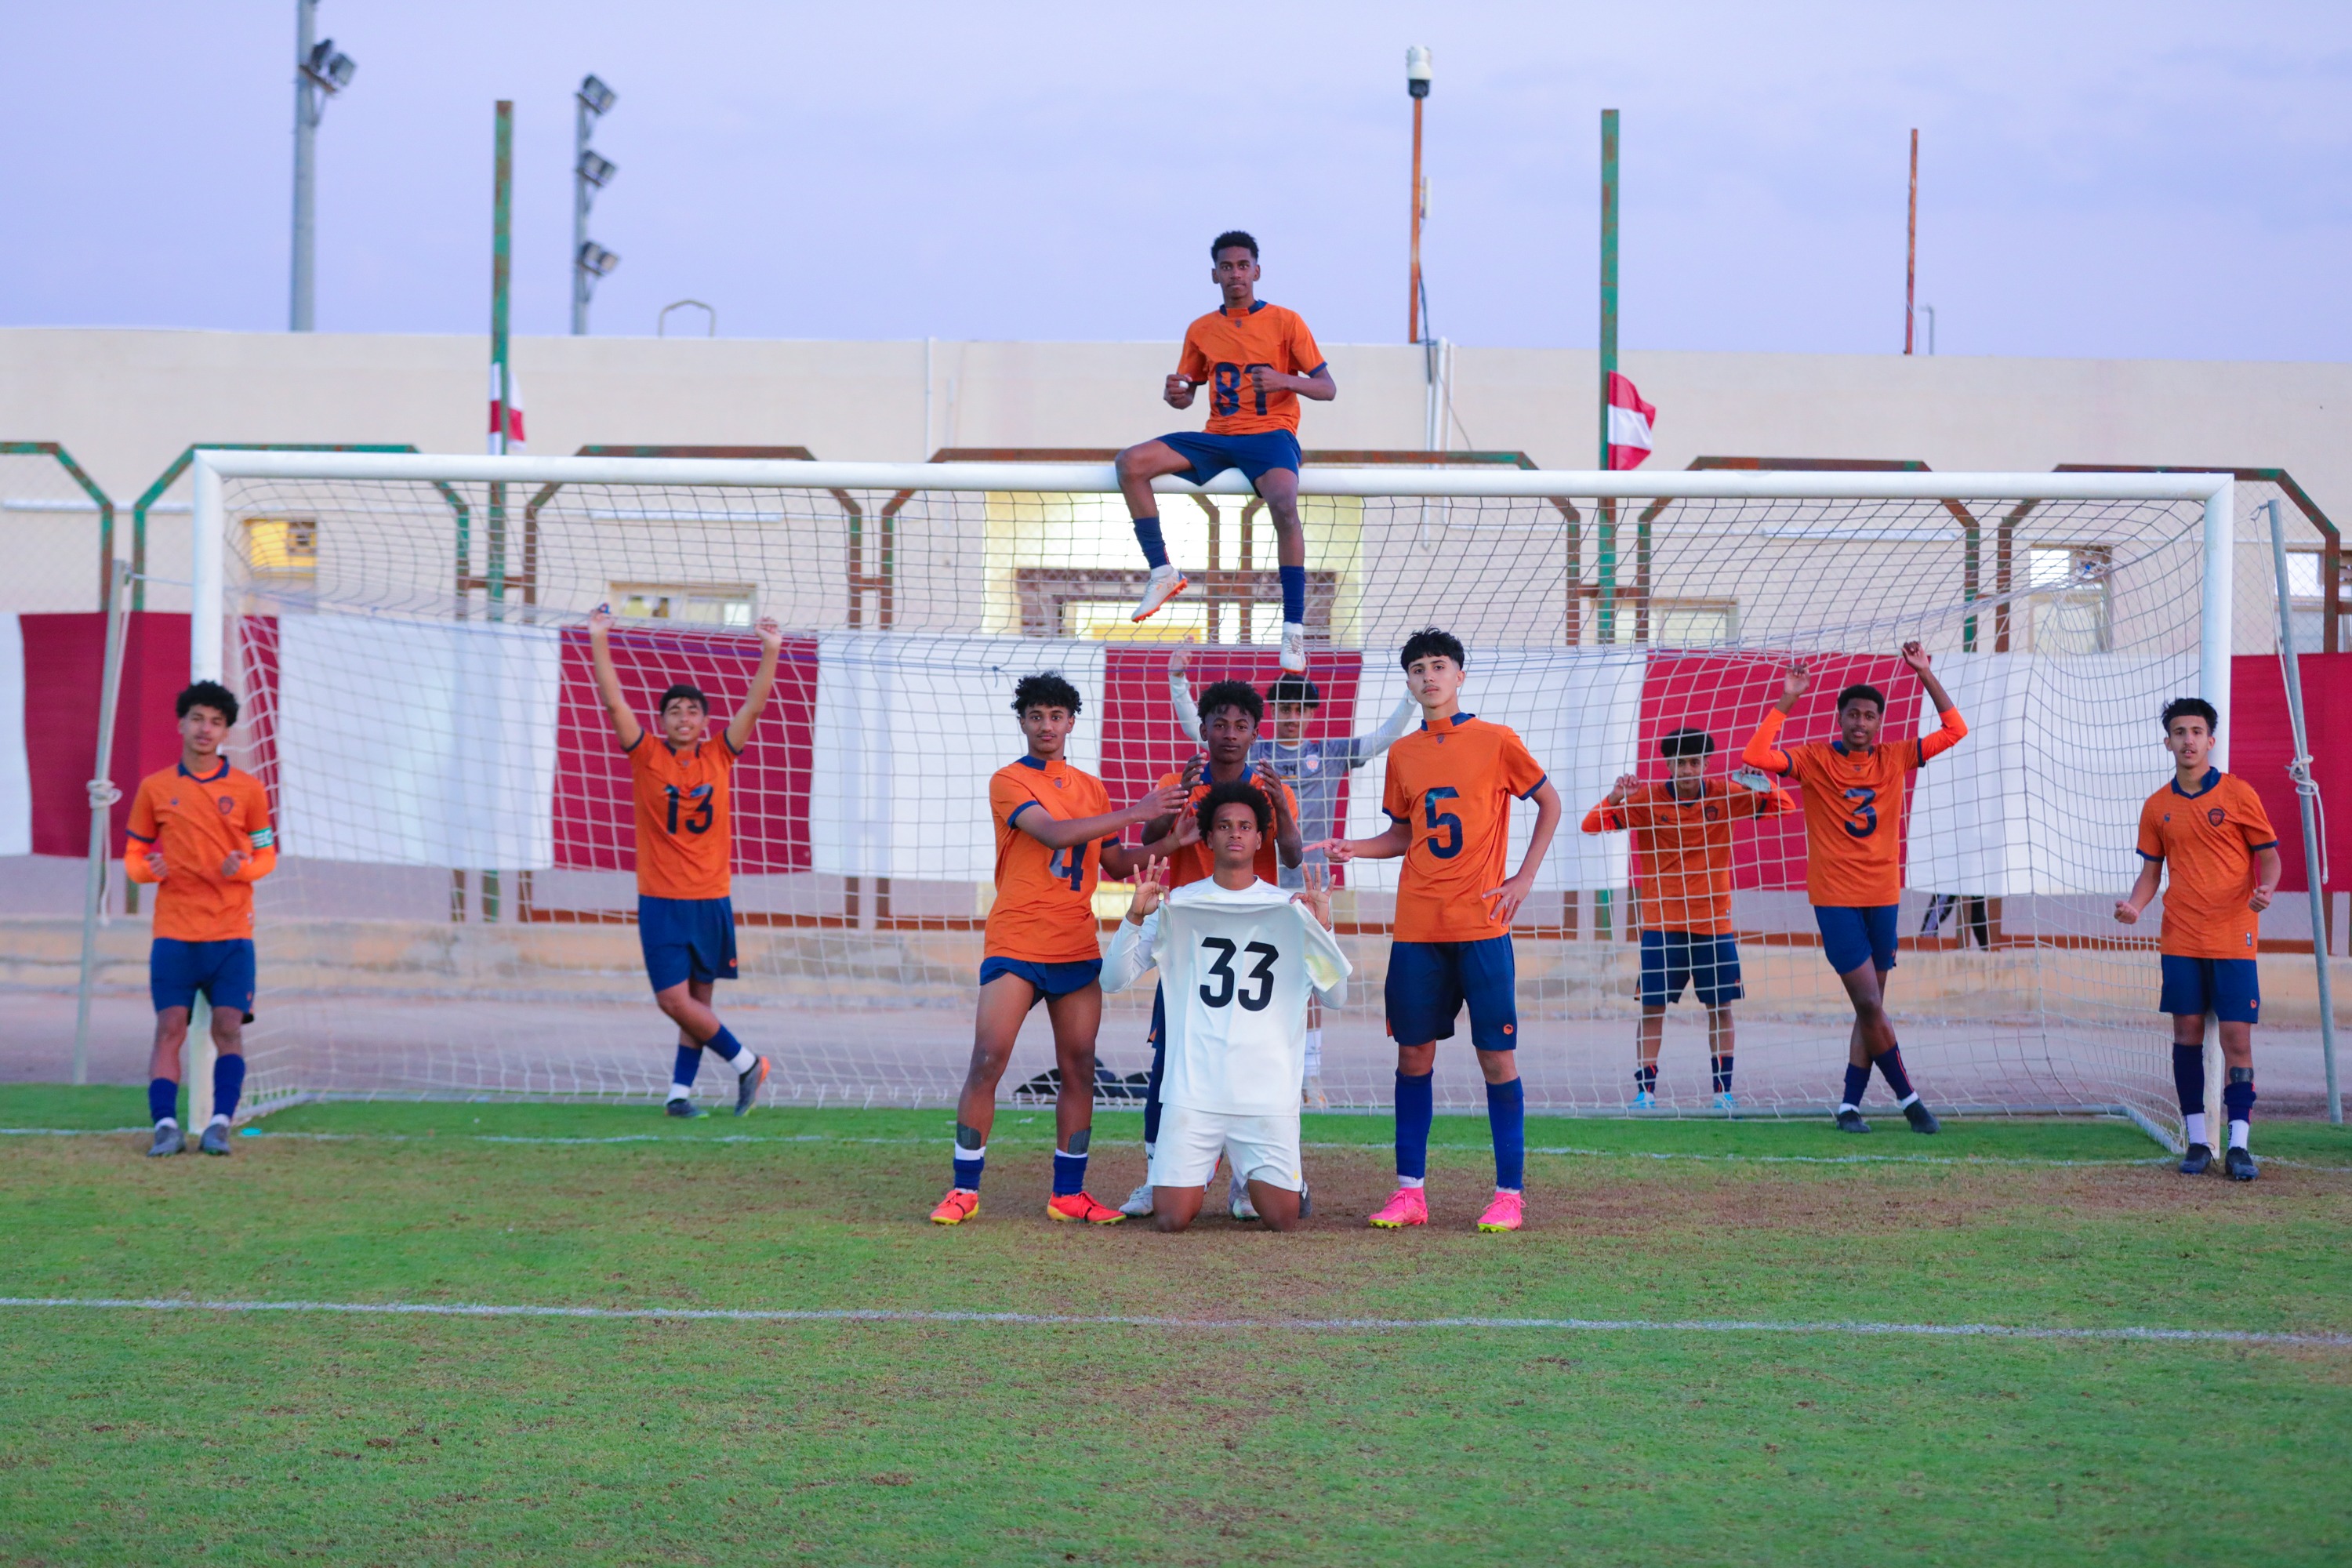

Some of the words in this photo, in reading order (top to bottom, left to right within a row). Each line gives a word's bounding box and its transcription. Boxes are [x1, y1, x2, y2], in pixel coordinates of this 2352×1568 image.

[665, 783, 713, 836] 13
[1425, 786, 1463, 859] 5
[1844, 788, 1877, 837] 3
[1049, 840, 1088, 891] 4
[1200, 937, 1279, 1011] 33
